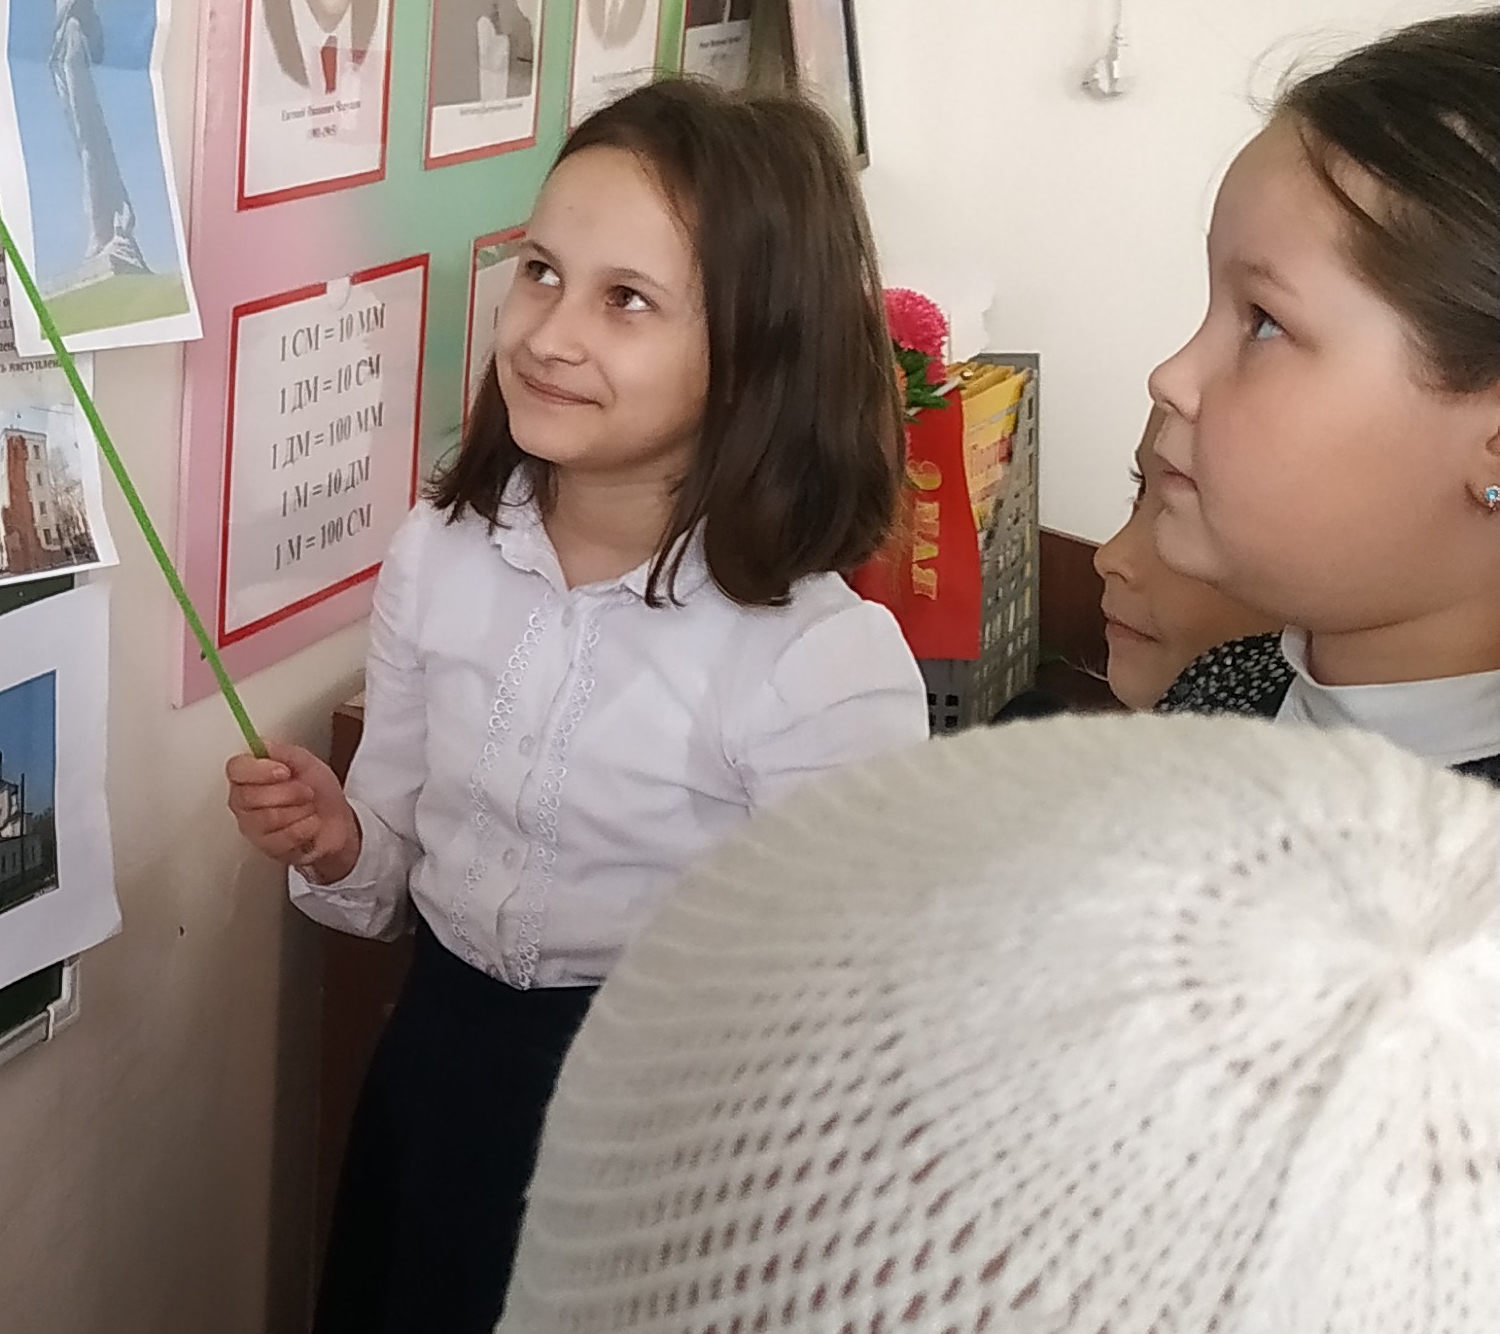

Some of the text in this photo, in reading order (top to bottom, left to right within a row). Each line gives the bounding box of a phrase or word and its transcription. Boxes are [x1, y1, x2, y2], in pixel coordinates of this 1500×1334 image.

[279, 334, 287, 362] 1
[291, 323, 321, 359] СМ
[338, 312, 354, 343] 10
[356, 302, 387, 335] ММ
[279, 387, 286, 415] 1
[290, 375, 319, 414] ДМ
[336, 364, 352, 396] 10
[355, 353, 381, 389] СМ
[271, 442, 278, 471] 1
[282, 431, 310, 469] ДМ
[328, 415, 352, 449] 100
[355, 401, 385, 435] ММ
[281, 489, 288, 517] 1
[292, 479, 308, 510] М
[327, 467, 342, 499] 10
[344, 456, 371, 494] ДМ
[274, 543, 282, 571] 1
[286, 533, 303, 565] М
[320, 516, 343, 551] 100
[346, 503, 372, 539] СМ
